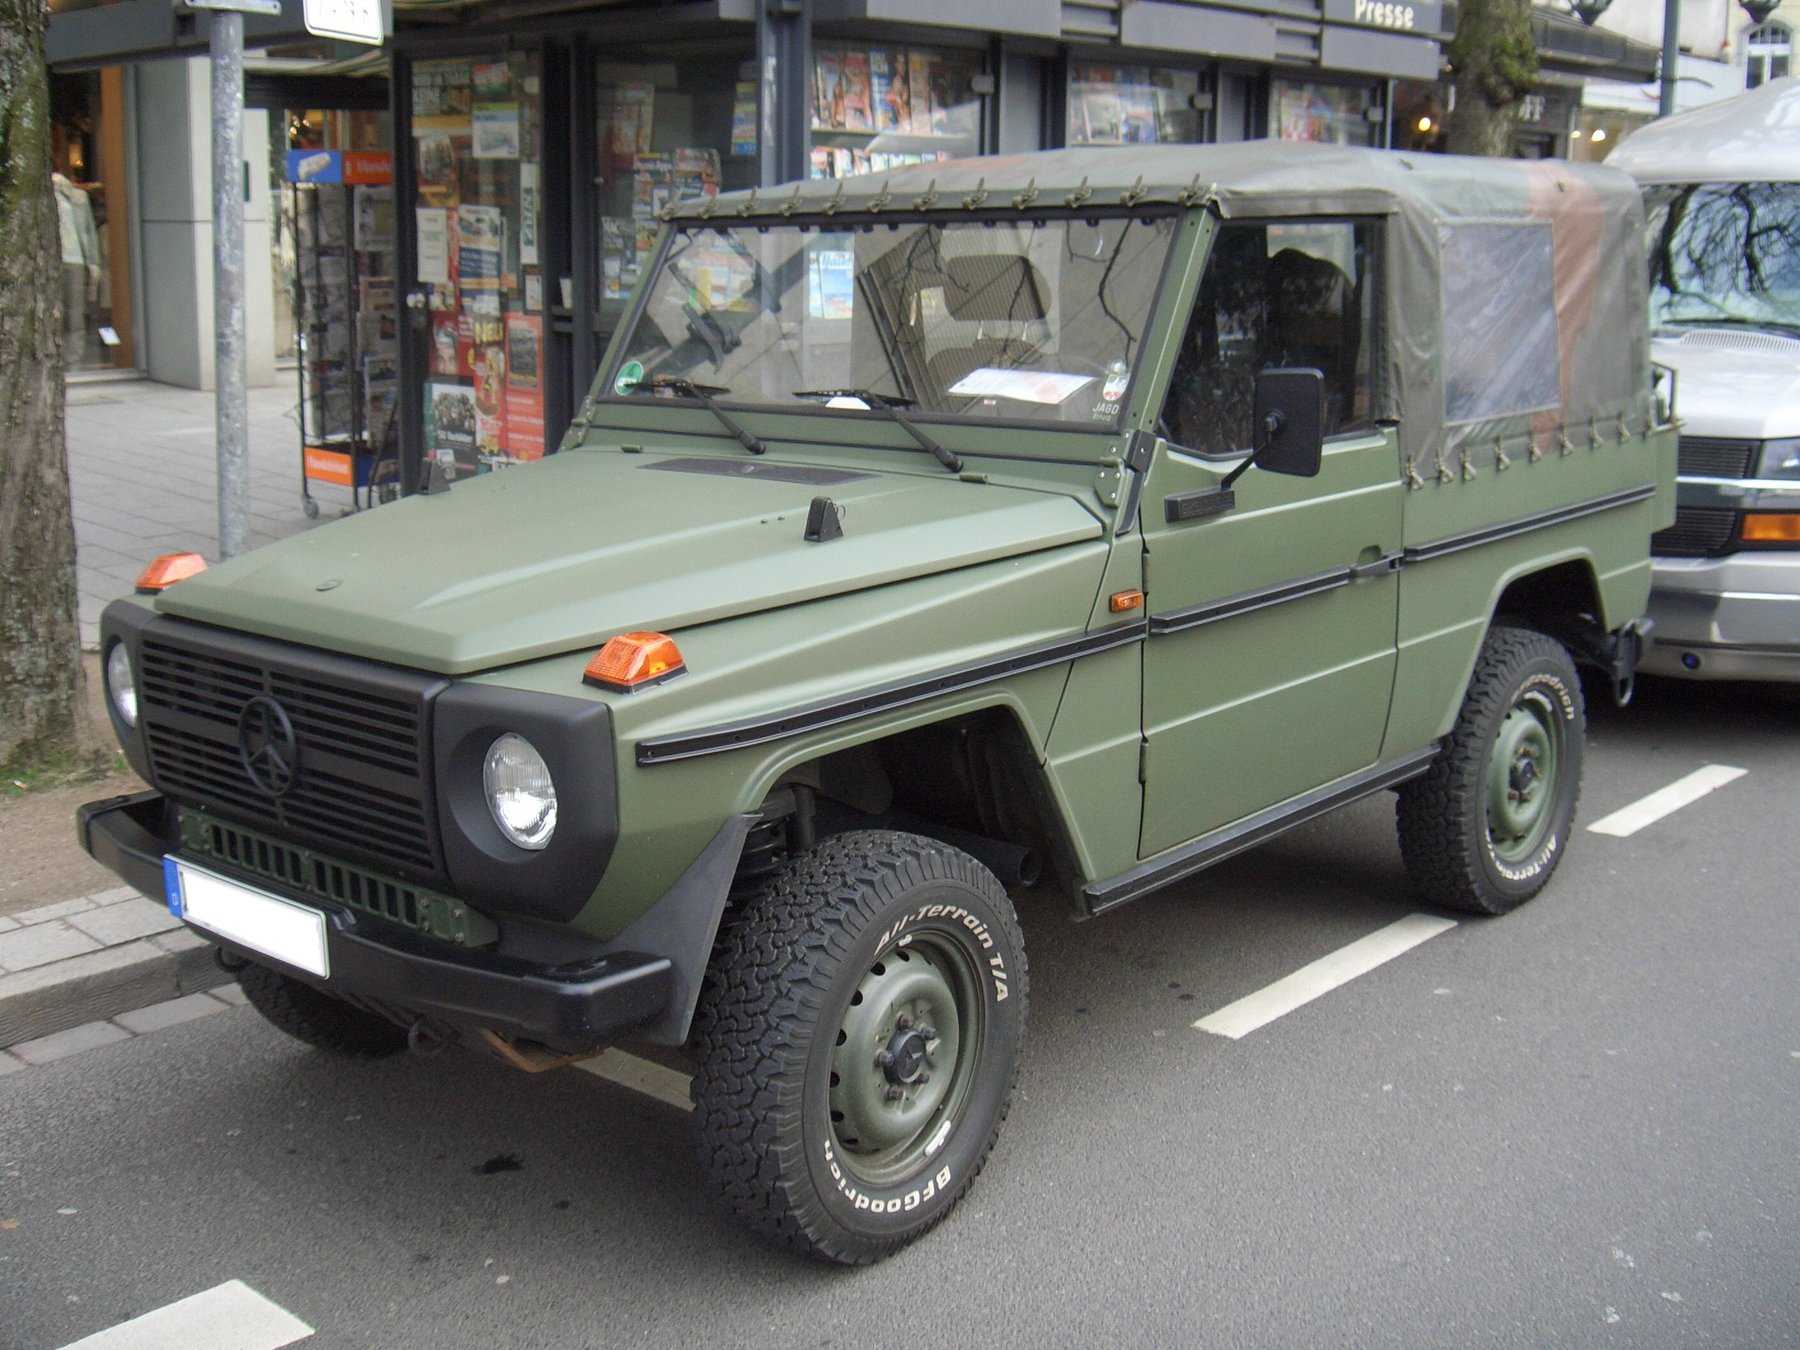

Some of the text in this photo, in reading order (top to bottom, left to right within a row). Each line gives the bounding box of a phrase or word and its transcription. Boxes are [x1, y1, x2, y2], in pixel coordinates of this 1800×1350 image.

[1355, 0, 1414, 29] Presse
[1092, 402, 1120, 415] JAGD
[874, 904, 1009, 1002] All-Terrain T/A
[824, 1139, 951, 1213] BFGoodrich
